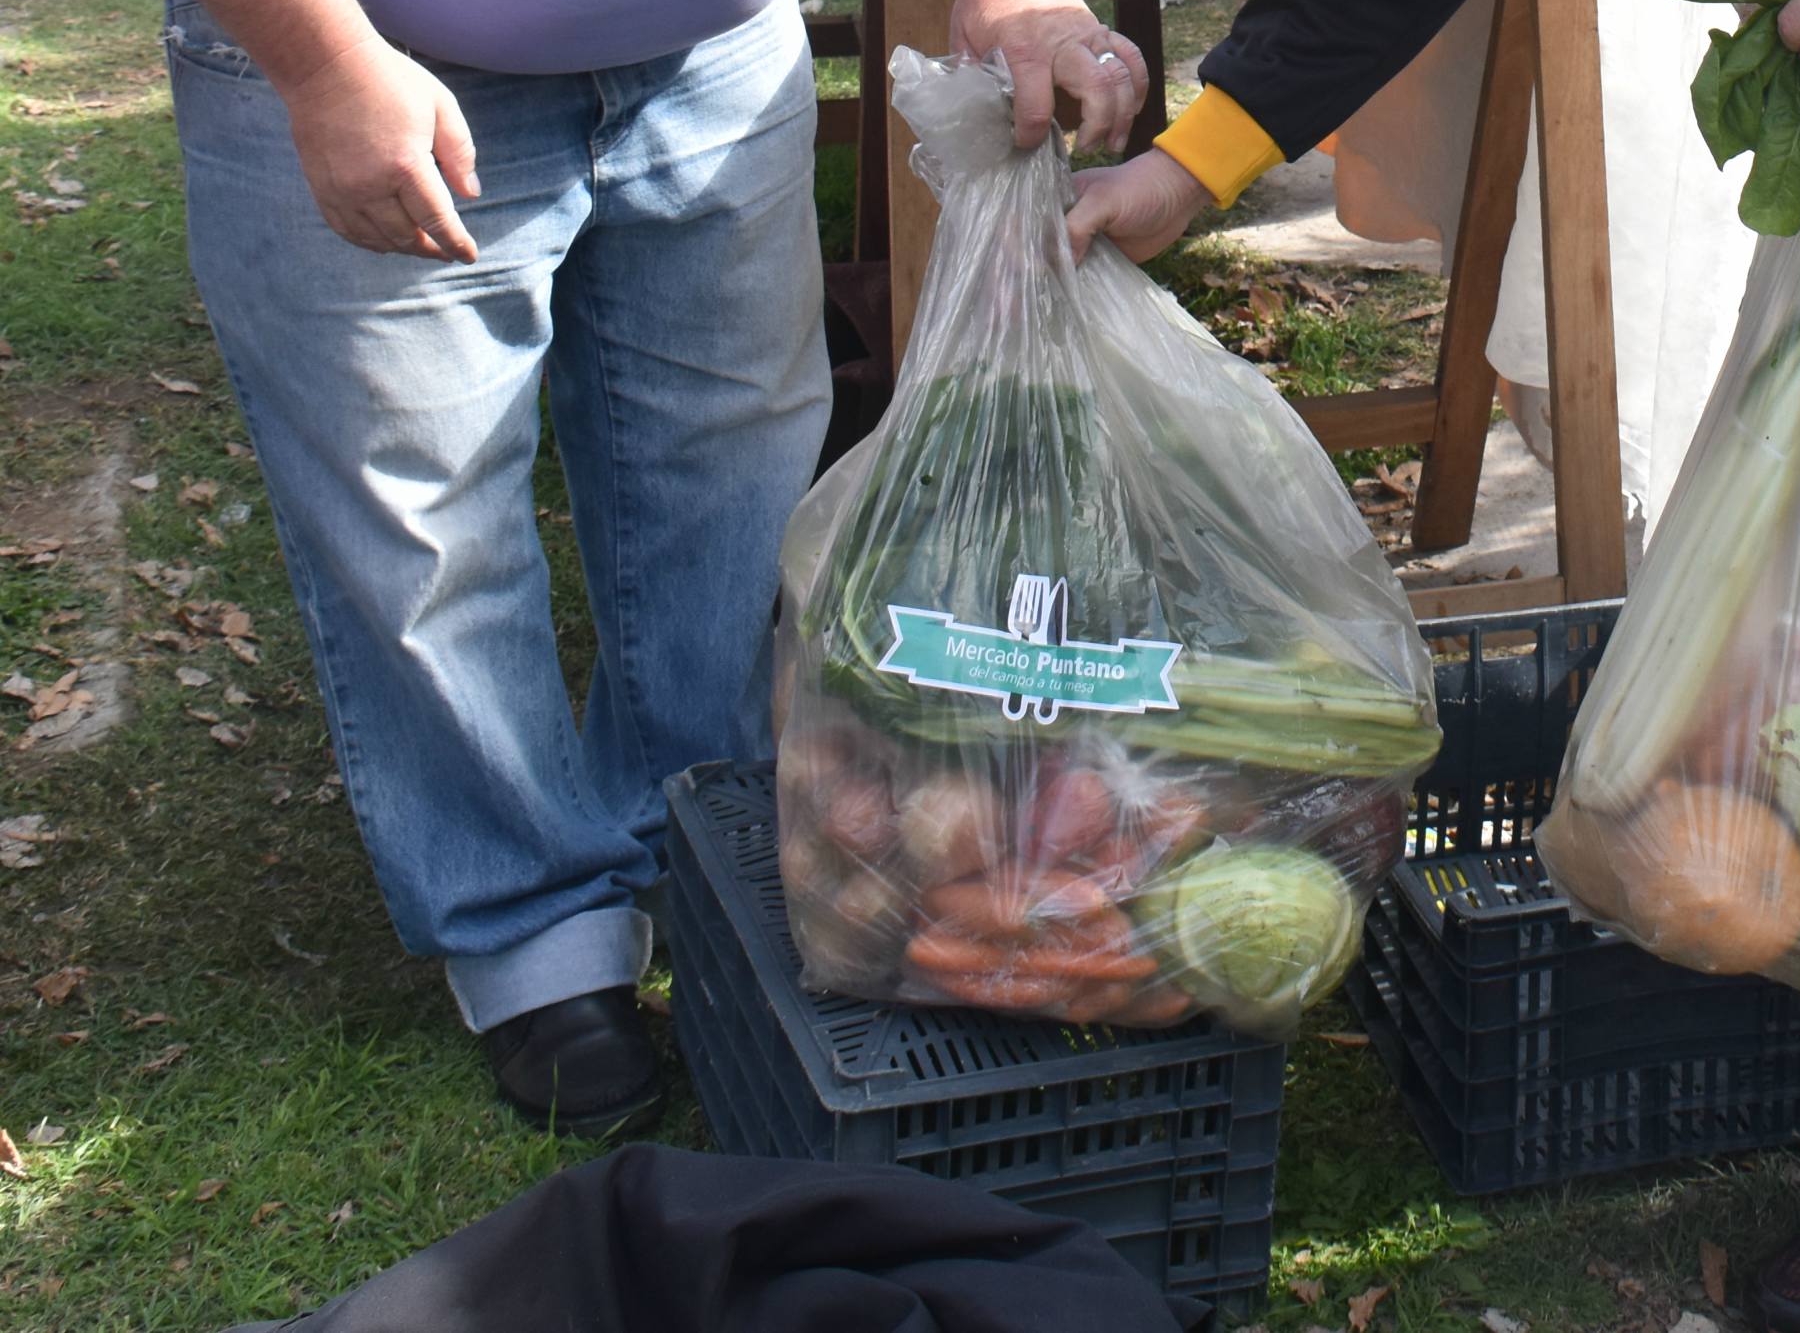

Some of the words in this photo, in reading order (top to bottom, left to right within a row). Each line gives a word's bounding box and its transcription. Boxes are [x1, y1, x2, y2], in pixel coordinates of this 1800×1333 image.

[945, 636, 1030, 670] Mercado
[1036, 651, 1126, 680] Puntano
[968, 665, 989, 679] del
[992, 670, 1035, 688] campo
[1037, 677, 1045, 687] a
[1049, 678, 1061, 691] tu
[1064, 682, 1095, 694] mesa
